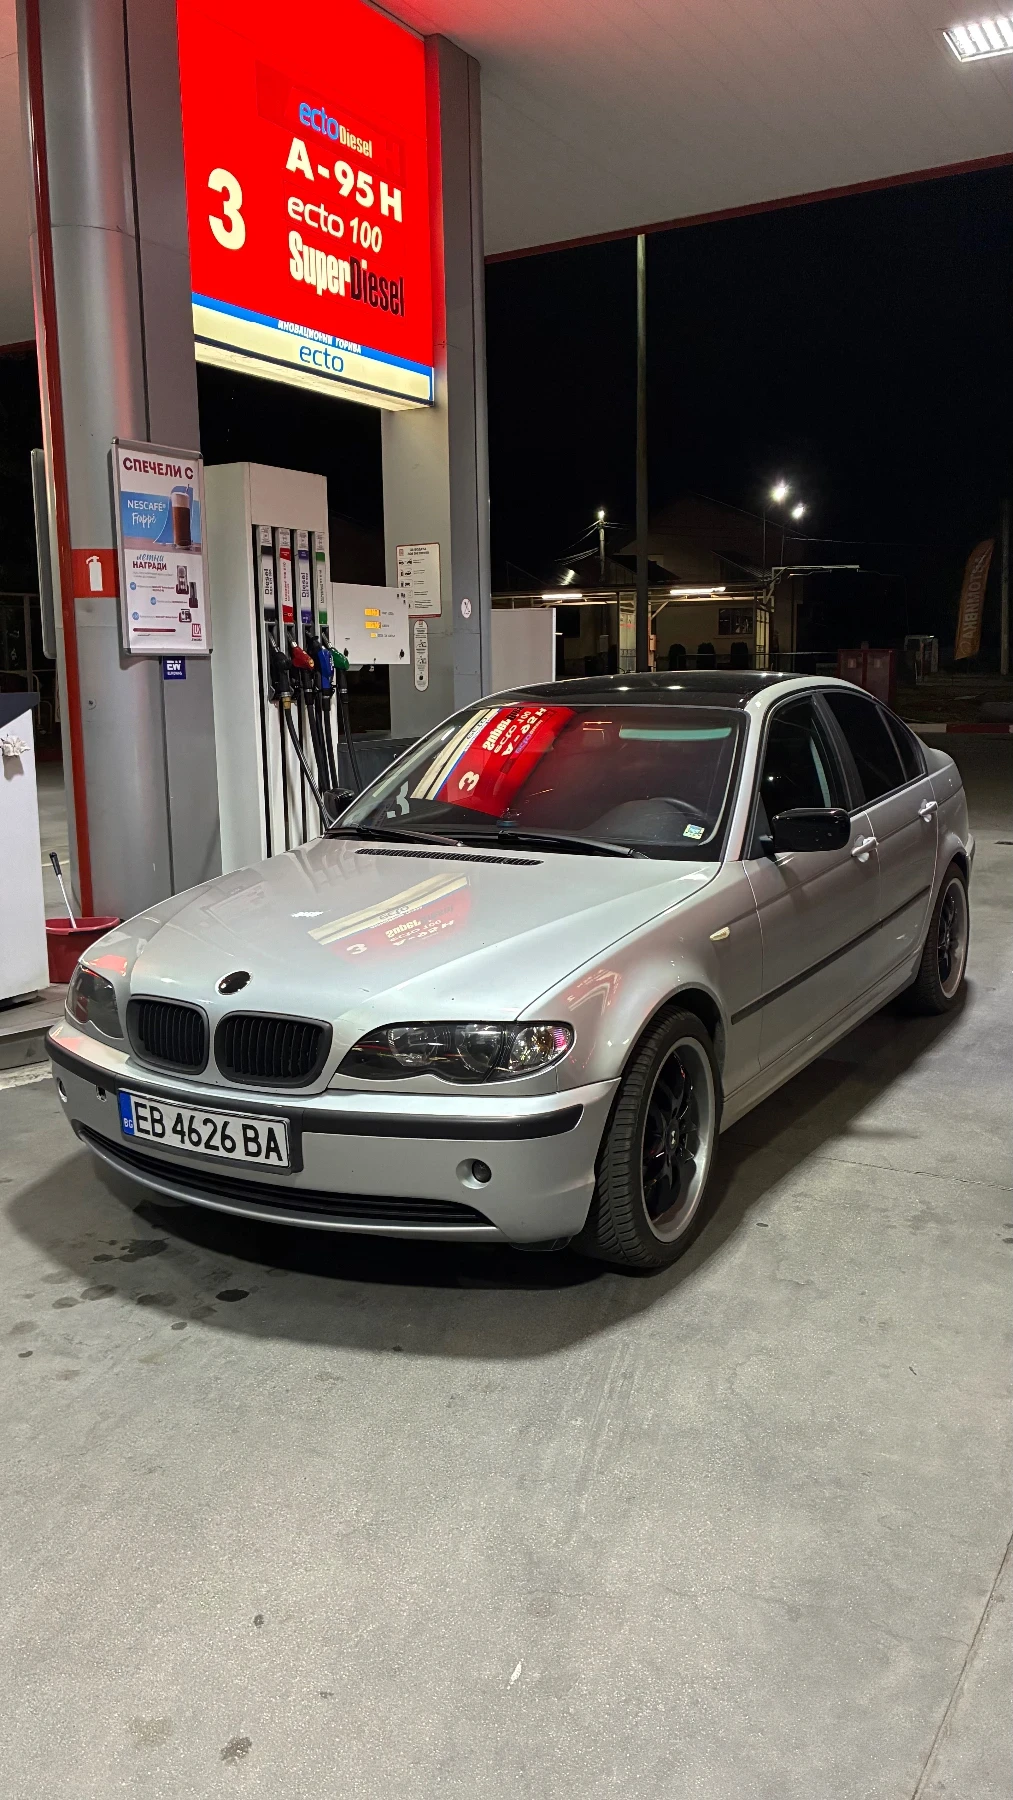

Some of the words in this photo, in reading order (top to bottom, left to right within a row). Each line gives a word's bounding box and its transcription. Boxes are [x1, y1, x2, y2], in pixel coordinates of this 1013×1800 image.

[208, 167, 246, 250] 3
[287, 196, 345, 238] ecto
[350, 217, 382, 253] 100
[299, 345, 344, 373] ecto
[122, 456, 182, 478] СПЕЧЕЛИ
[184, 466, 194, 480] С
[132, 560, 167, 571] НАГРАДИ
[123, 1117, 134, 1129] BG
[134, 1102, 165, 1138] EB
[171, 1112, 237, 1153] 4626
[241, 1123, 283, 1162] BA
